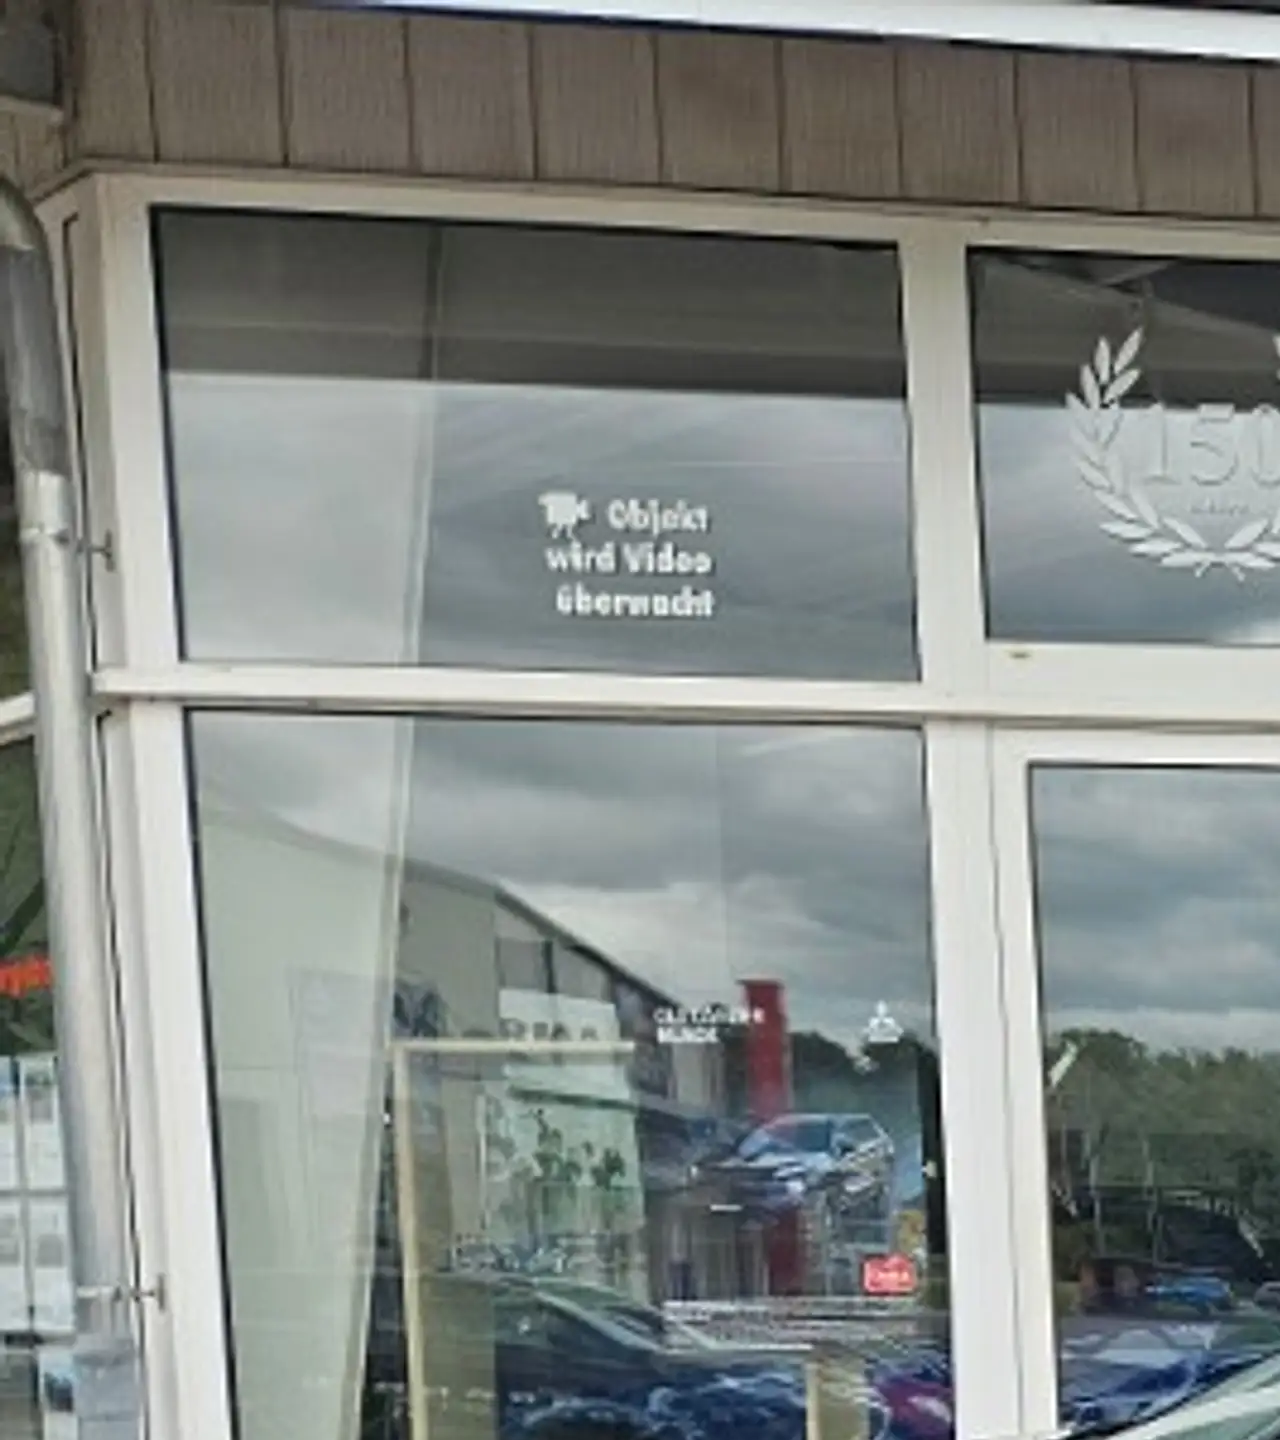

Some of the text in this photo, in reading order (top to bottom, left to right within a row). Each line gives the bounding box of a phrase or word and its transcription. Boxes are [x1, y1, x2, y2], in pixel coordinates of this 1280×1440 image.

[608, 498, 709, 537] Objekt
[547, 541, 712, 573] wird Video
[556, 582, 714, 616] überwacht
